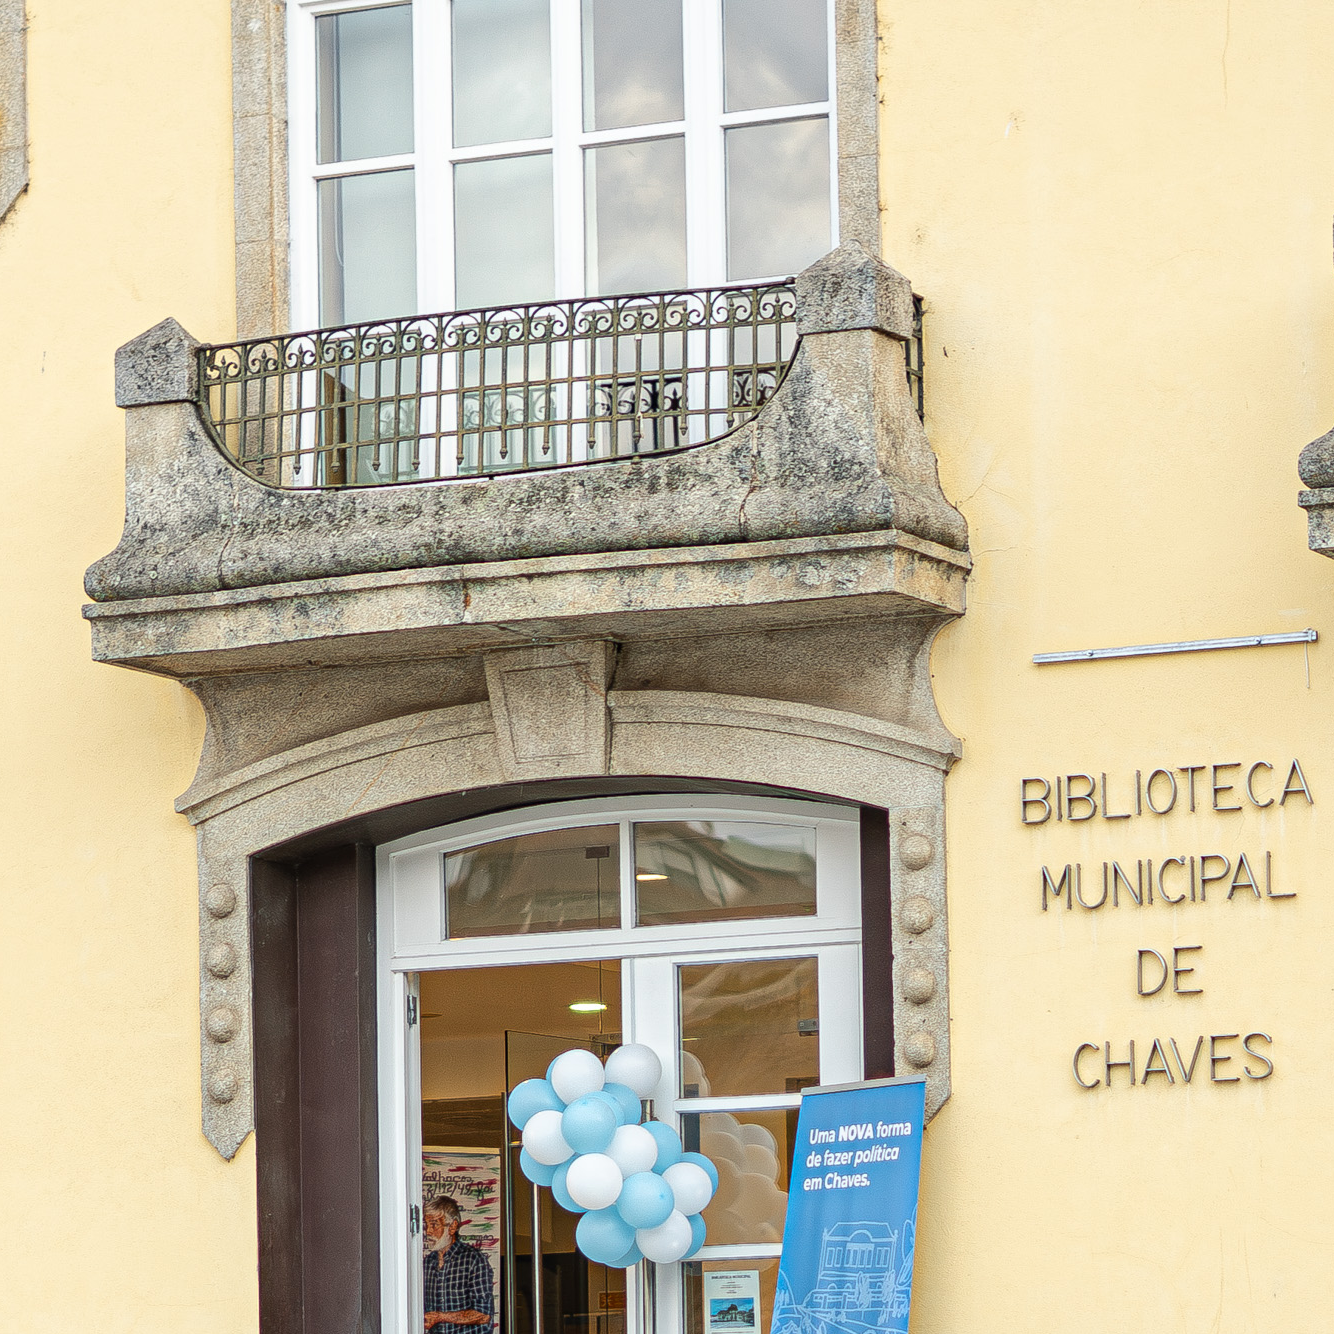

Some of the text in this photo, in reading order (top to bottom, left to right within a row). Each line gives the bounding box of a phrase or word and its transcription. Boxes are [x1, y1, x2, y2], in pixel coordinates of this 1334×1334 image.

[1021, 759, 1314, 825] BIBLIOTECA
[1042, 851, 1297, 911] MUNICIPAL
[1137, 945, 1204, 996] DE
[1073, 1032, 1274, 1089] CHAVES
[806, 1144, 900, 1168] de fazer política
[809, 1120, 912, 1145] Uma NOVA forma
[803, 1171, 870, 1191] em Chaves.
